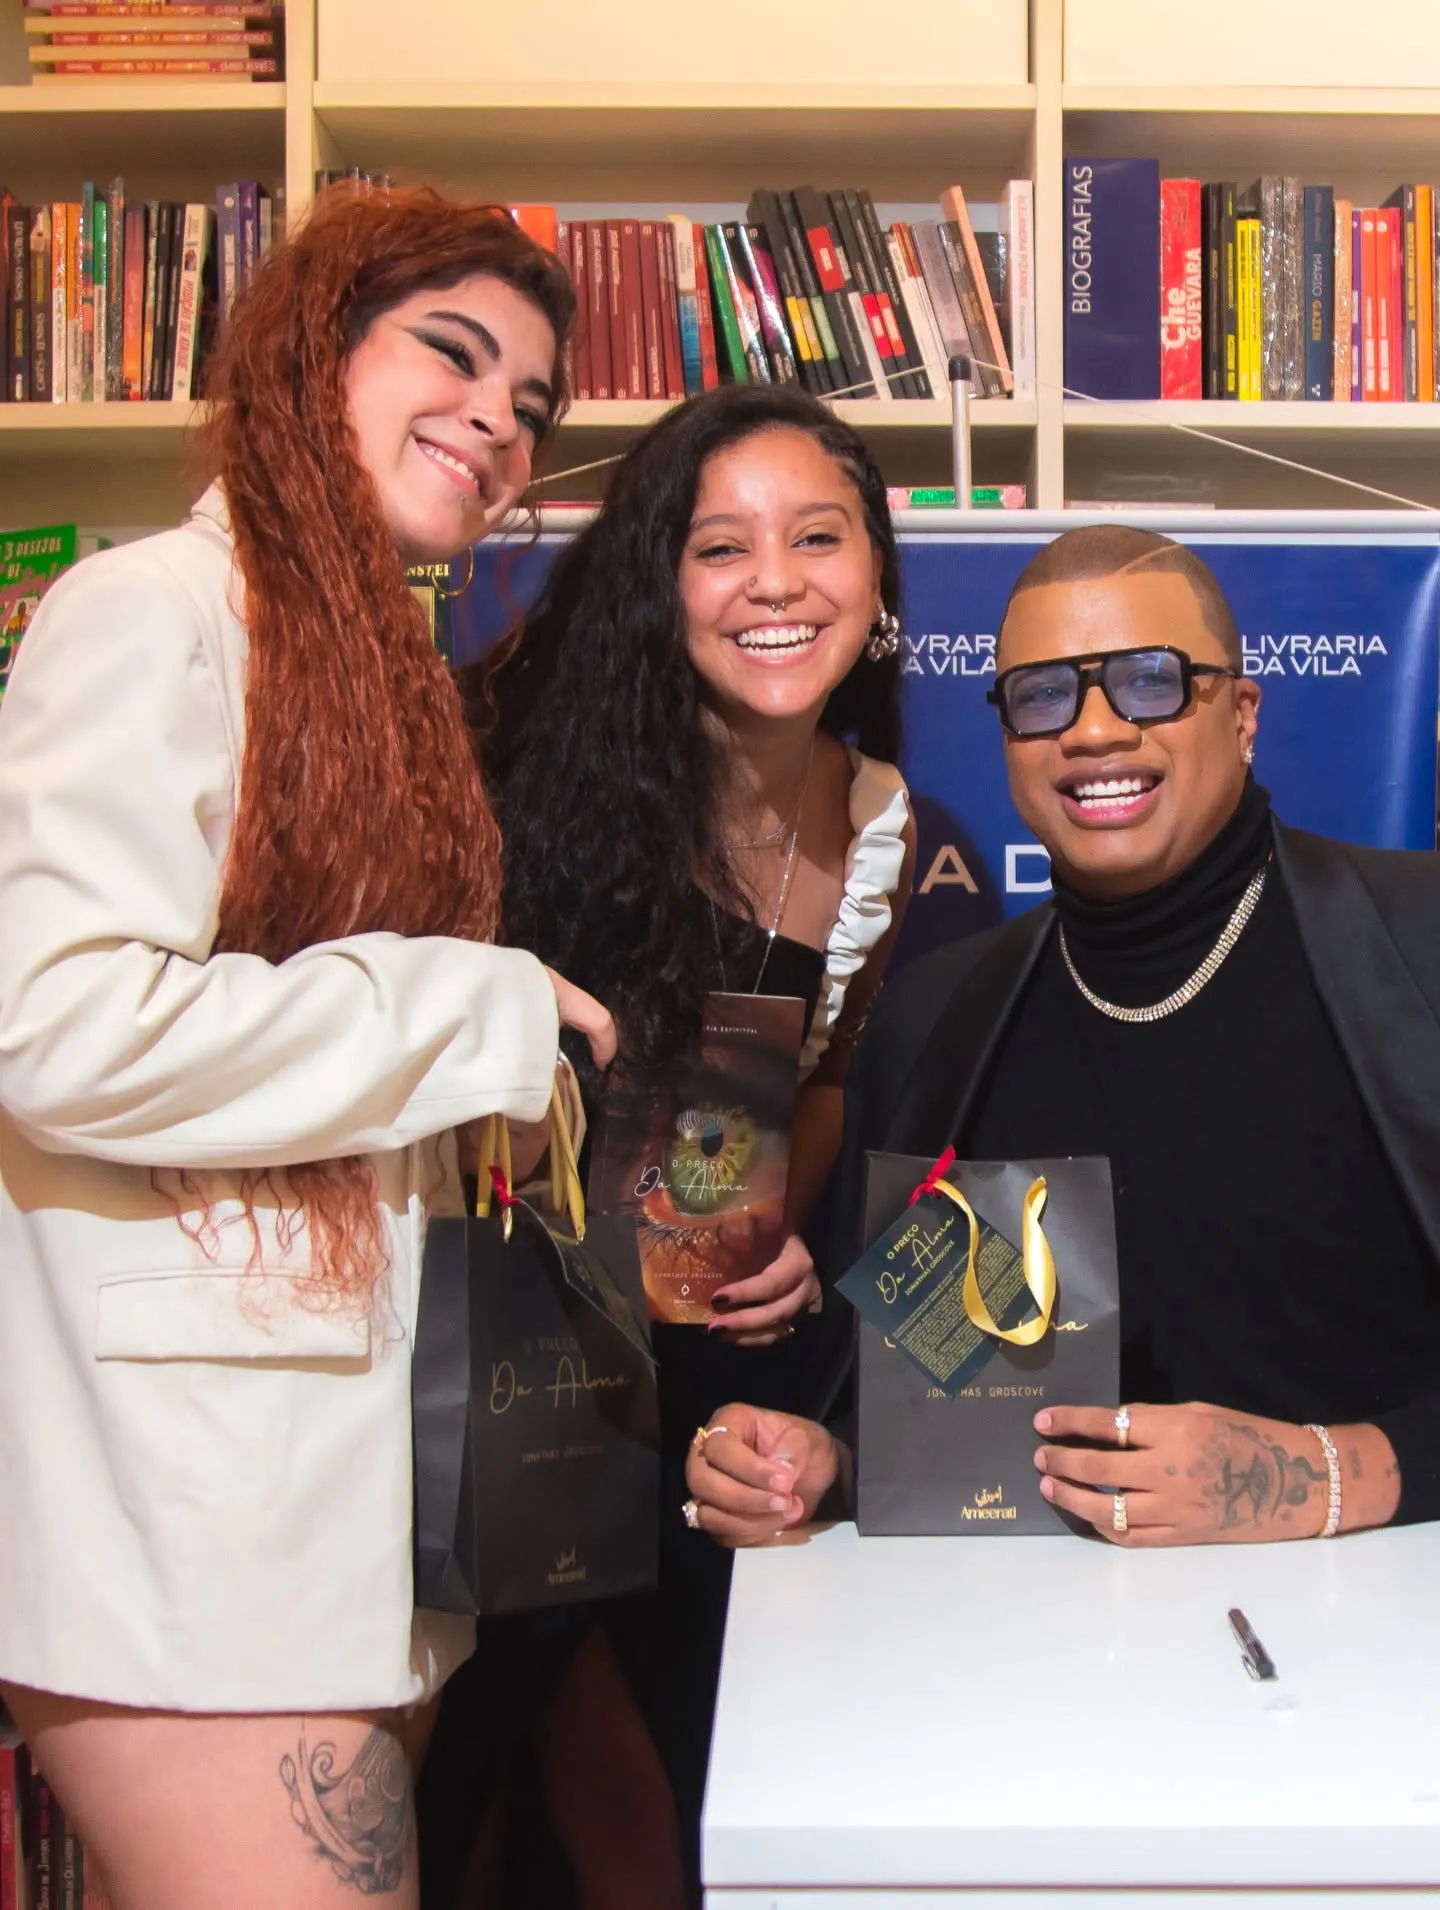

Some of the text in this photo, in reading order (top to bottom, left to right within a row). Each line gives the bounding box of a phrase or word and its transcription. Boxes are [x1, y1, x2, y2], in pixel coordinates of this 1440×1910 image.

[1072, 166, 1093, 313] BIOGRAFIAS
[1185, 247, 1202, 341] GUEVARA
[1160, 288, 1187, 350] Che
[4, 540, 14, 560] 3
[904, 634, 997, 655] VRAR
[1242, 634, 1389, 655] LIVRARIA
[902, 655, 997, 676] A VILA
[1242, 655, 1362, 677] DA VILA
[671, 1159, 679, 1168] O
[634, 1165, 749, 1200] Da Alma
[886, 1224, 919, 1260] O PREÇO
[876, 1271, 906, 1304] Da
[912, 1215, 955, 1270] Alma
[490, 1355, 632, 1415] Da Alma
[926, 1386, 1046, 1398] JONHAS GROSCOVE
[960, 1505, 1017, 1520] Ameerati
